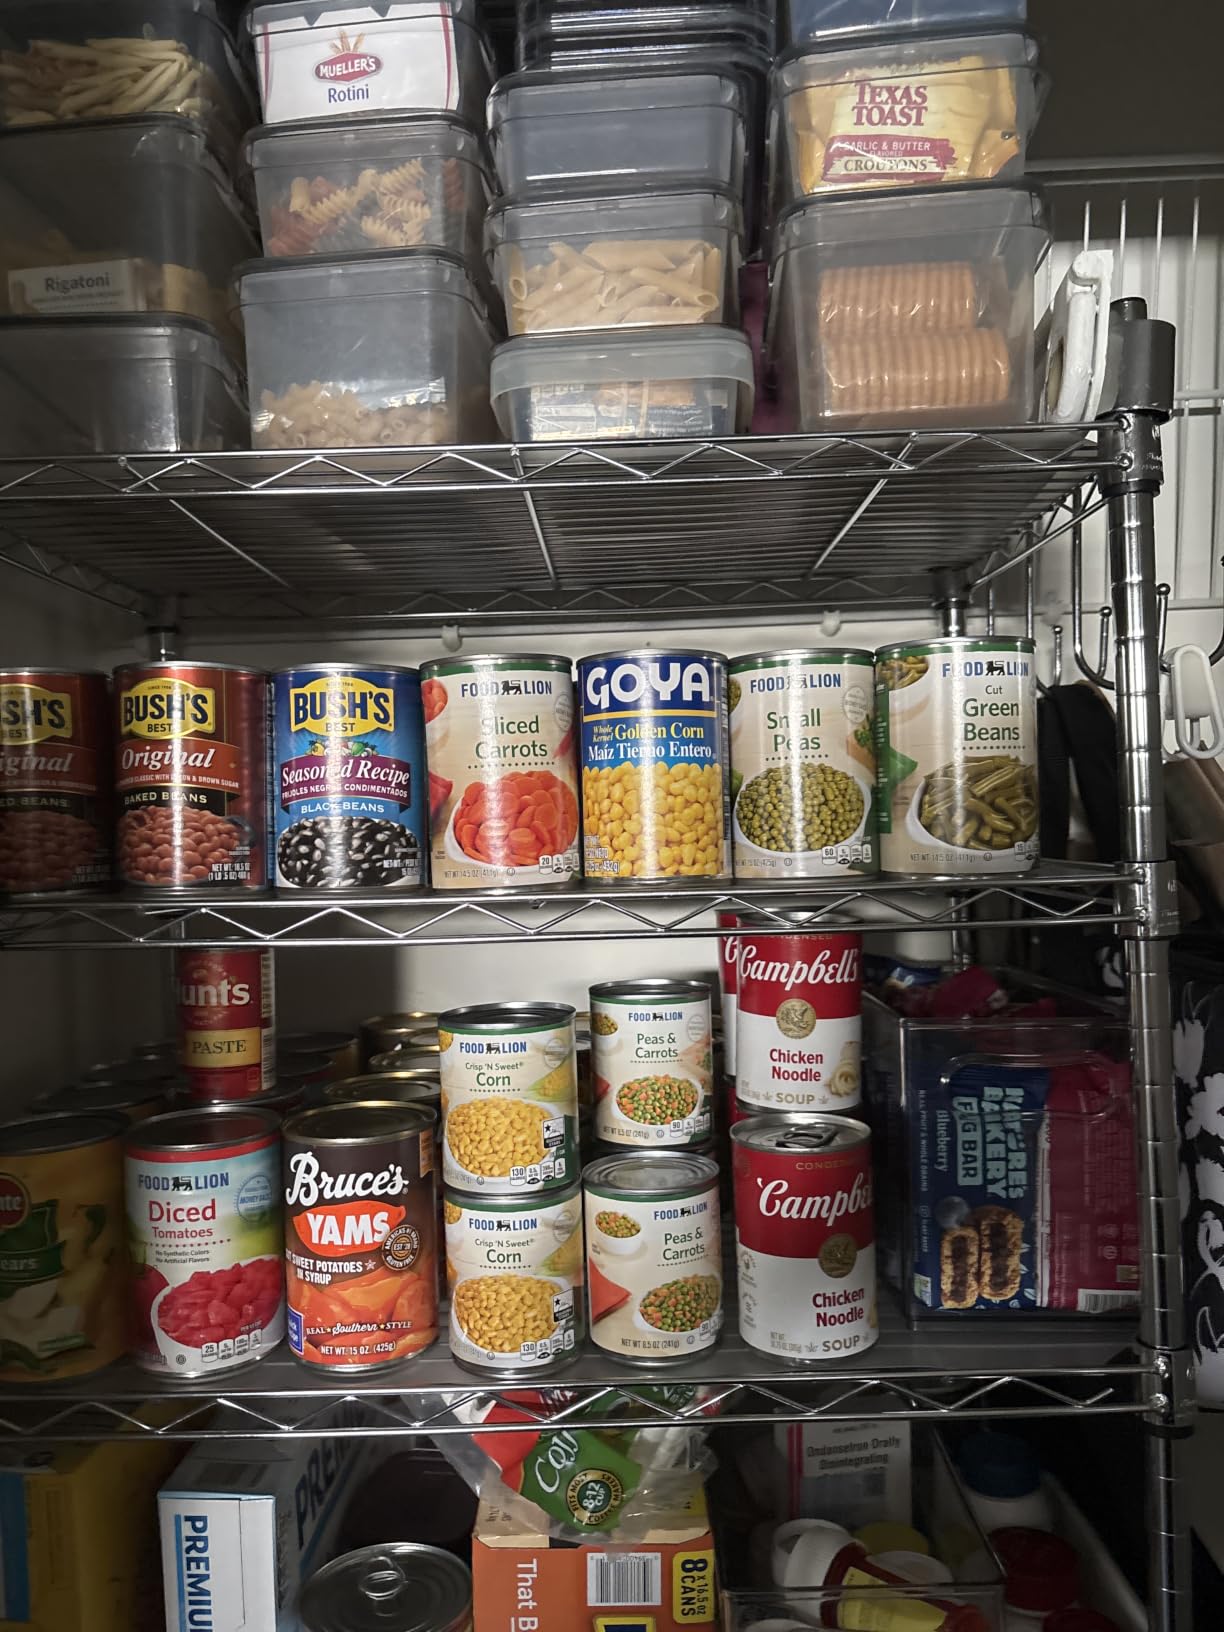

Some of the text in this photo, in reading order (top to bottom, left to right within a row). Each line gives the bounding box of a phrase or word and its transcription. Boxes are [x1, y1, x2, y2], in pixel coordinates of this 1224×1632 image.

[319, 56, 377, 78] MUELLER'S
[328, 84, 369, 103] Rotini
[855, 82, 928, 105] TEXAS
[852, 106, 928, 126] TOAST
[882, 142, 888, 150] &
[892, 142, 931, 151] BUTTER
[44, 272, 110, 294] Rigatoni
[942, 661, 1029, 678] FOD LION
[461, 681, 553, 698] FOOD LION
[586, 662, 710, 710] GOYA
[750, 673, 841, 693] FOOD LION
[985, 684, 1003, 695] Cut
[0, 698, 66, 729] SH'S
[123, 693, 209, 727] BUSH'S
[293, 690, 390, 726] BUSH'S
[962, 698, 1020, 718] Green
[147, 723, 173, 732] BEST
[325, 722, 356, 732] BEST
[482, 715, 540, 735] Sliced
[767, 708, 821, 730] Small
[592, 733, 614, 743] Kernel
[593, 725, 613, 733] Whole
[614, 722, 705, 740] Golden Corn
[963, 722, 1020, 742] Beans
[122, 745, 215, 771] Original
[476, 740, 548, 760] Carrots
[588, 744, 614, 761] Maíz
[668, 741, 712, 758] Entero
[0, 751, 74, 776] iginal
[198, 776, 220, 785] BROWN
[282, 759, 410, 787] Seasond Recipe
[124, 792, 157, 805] BAKED
[344, 783, 408, 798] CONDIMENTADOS
[343, 801, 385, 813] BEANS
[541, 857, 550, 865] 20
[824, 848, 834, 856] 60
[740, 945, 859, 991] Campbell's
[628, 1011, 683, 1022] FOOD LION
[192, 1039, 247, 1054] PASTE
[459, 1041, 527, 1054] FOOD LION
[637, 1032, 677, 1045] Peas &
[635, 1047, 678, 1059] Carrots
[769, 1048, 824, 1065] Chicken
[465, 1062, 483, 1071] Crisp
[771, 1066, 822, 1082] Noodle
[476, 1072, 511, 1086] Corn
[775, 1092, 816, 1105] SOUP
[934, 1110, 951, 1173] Blueberry
[981, 1086, 1007, 1198] BAKERY
[919, 1139, 929, 1164] WHOLE
[961, 1140, 978, 1179] BAR
[286, 1151, 409, 1206] Bruce's
[511, 1168, 524, 1176] 130
[138, 1172, 230, 1191] FOOD LION
[148, 1198, 217, 1223] Diced
[654, 1202, 708, 1220] FOOD LION
[152, 1226, 214, 1239] Tomatoes
[306, 1211, 391, 1246] YAMS
[469, 1218, 537, 1231] FOOD LION
[475, 1238, 493, 1247] Crisp
[664, 1226, 703, 1245] Peas &
[486, 1249, 522, 1263] Corn
[662, 1243, 705, 1261] Carrots
[0, 1257, 38, 1271] ears
[292, 1254, 363, 1273] SWEET POTATOES
[297, 1268, 332, 1285] IN SYRUP
[812, 1288, 865, 1309] Chicken
[701, 1322, 709, 1331] 90
[816, 1309, 865, 1328] Noodle
[306, 1321, 412, 1336] REAL Southern STYLE
[205, 1345, 215, 1354] 25
[321, 1346, 333, 1355] NET
[350, 1346, 358, 1355] 15
[373, 1341, 397, 1354] (425g)
[522, 1344, 535, 1352] 130
[621, 1338, 631, 1347] NET
[632, 1340, 641, 1348] WT
[822, 1335, 861, 1352] SOUP
[872, 1436, 901, 1449] Orally
[569, 1495, 579, 1511] FITS
[602, 1474, 620, 1502] MAKERS
[582, 1482, 601, 1509] 8-12
[595, 1487, 606, 1506] CUP
[184, 1514, 213, 1632] PREMIU
[681, 1558, 708, 1573] 8
[697, 1583, 709, 1602] 16.5
[516, 1558, 538, 1609] That
[681, 1575, 696, 1616] CANS
